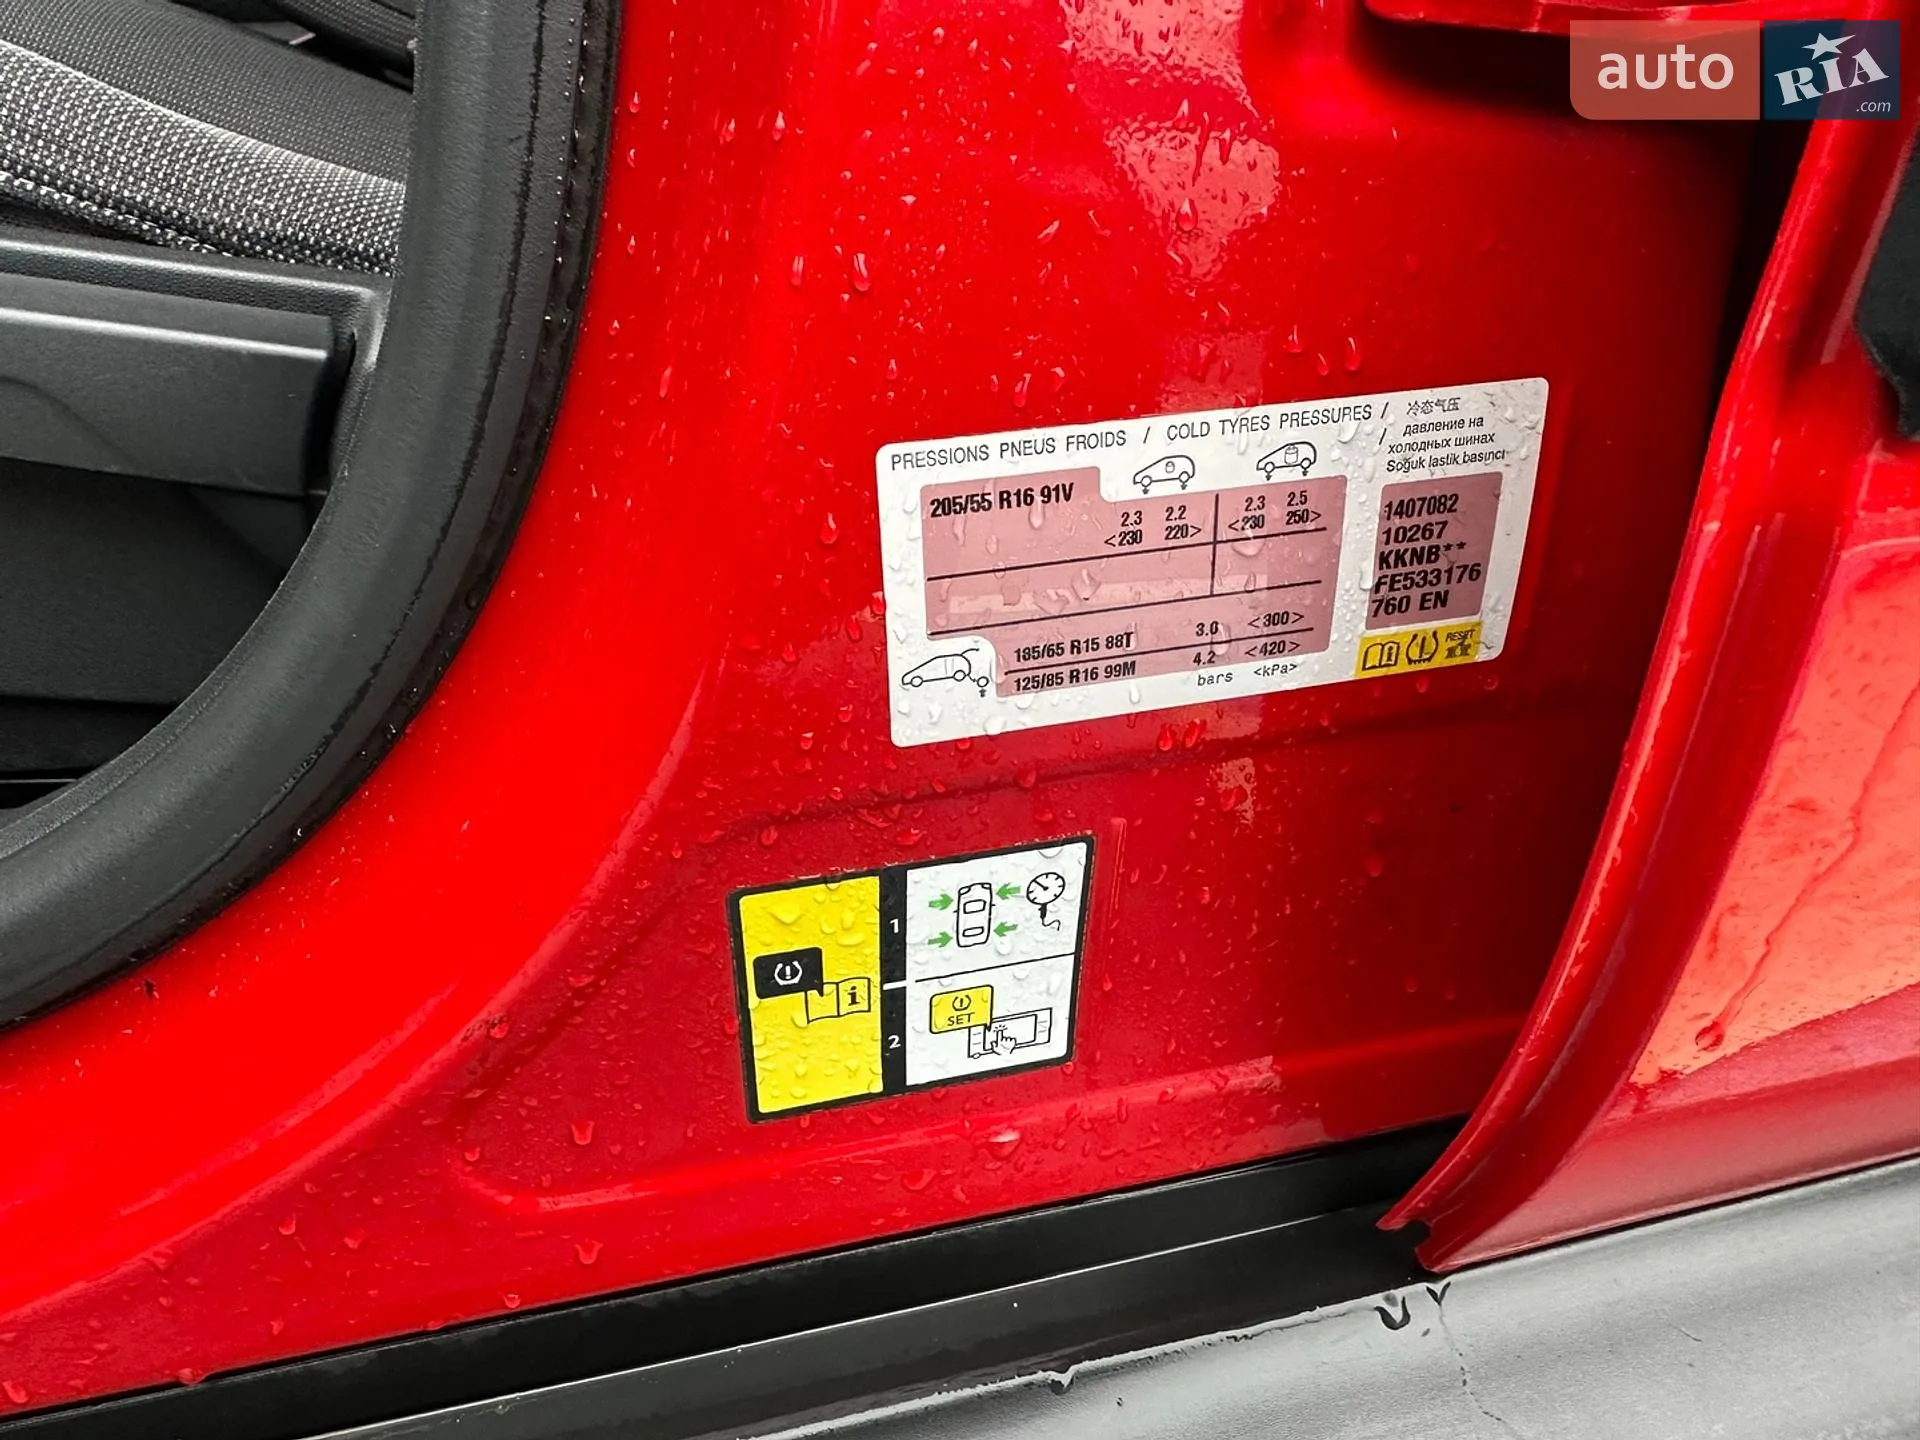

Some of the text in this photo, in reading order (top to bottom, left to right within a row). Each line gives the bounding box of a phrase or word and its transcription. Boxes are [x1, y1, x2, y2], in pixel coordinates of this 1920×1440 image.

[891, 445, 990, 471] PRESSIONS
[1000, 437, 1057, 459] PNEUS
[1066, 430, 1127, 451] FROIDS
[1167, 421, 1211, 441] COLD
[1219, 415, 1270, 436] TYRES
[1280, 404, 1372, 429] PRESSURES
[1403, 418, 1465, 437] давление
[1469, 416, 1484, 428] на
[1388, 432, 1496, 455] холодных шинах
[1387, 456, 1425, 473] Soğuk
[1428, 451, 1460, 468] lastik
[929, 482, 1075, 519] 205/55 R16 91V
[1245, 490, 1308, 512] 2.3 2.5
[1384, 493, 1460, 521] 1407082
[1120, 505, 1187, 527] 2.3 2.2
[1228, 508, 1323, 532] <230 250>
[1104, 525, 1203, 548] <230 220>
[1382, 520, 1449, 546] 10267
[1374, 562, 1482, 595] FE533176
[1372, 590, 1450, 618] 760 EN
[1195, 610, 1304, 637] 3.0 <300>
[1014, 631, 1134, 663] 185/65 R15 88T
[1193, 639, 1301, 666] 4.2 <420>
[1014, 660, 1136, 692] 125/85 R16 99M
[1197, 663, 1298, 687] bars <kPa>
[890, 918, 899, 933] 1
[946, 1012, 975, 1026] SET
[888, 1035, 901, 1049] 2
